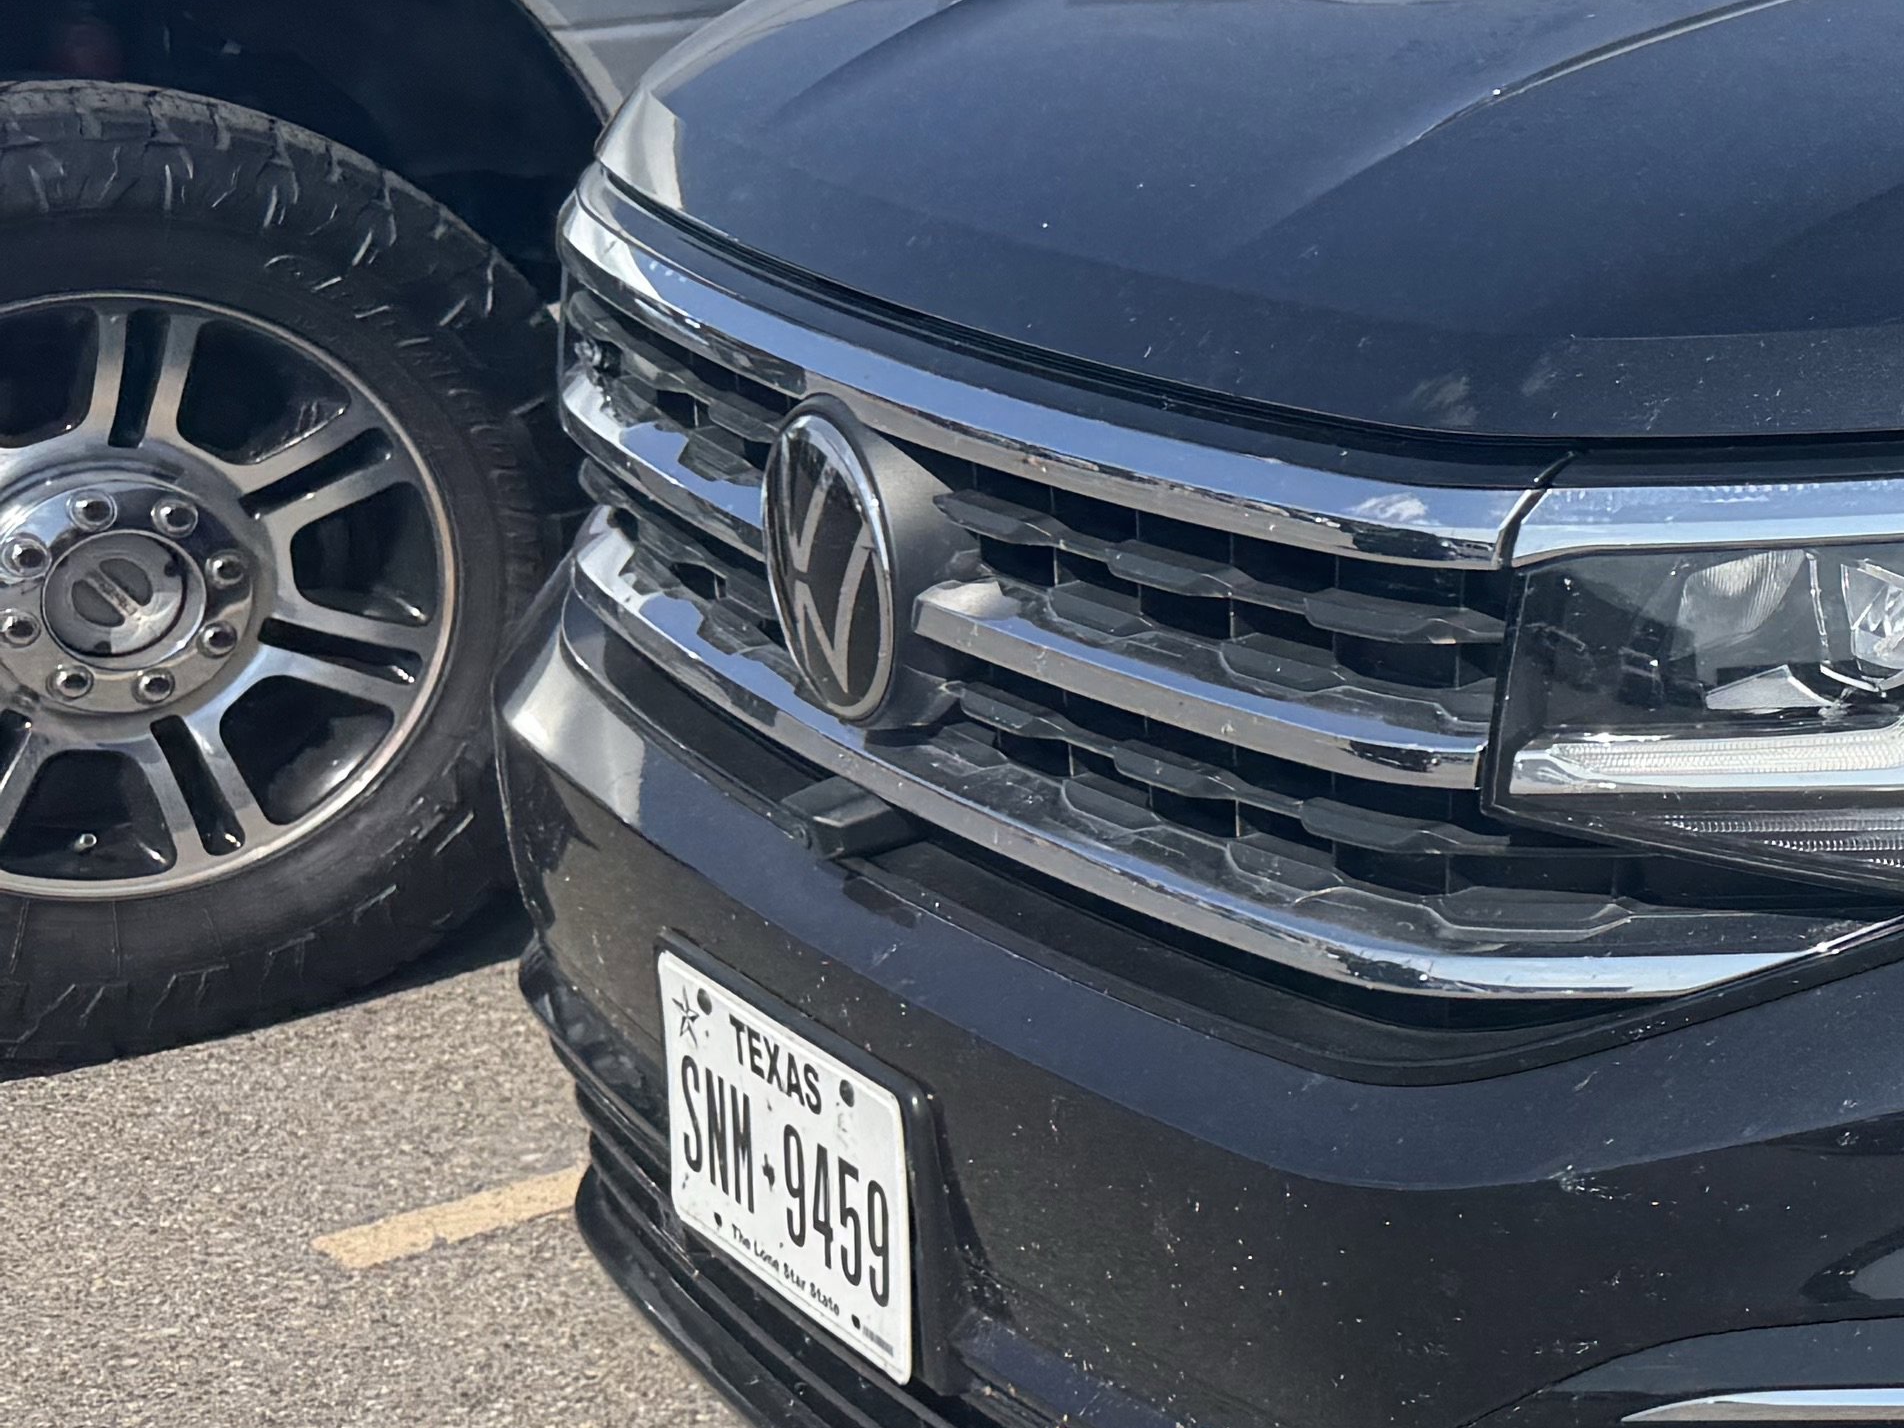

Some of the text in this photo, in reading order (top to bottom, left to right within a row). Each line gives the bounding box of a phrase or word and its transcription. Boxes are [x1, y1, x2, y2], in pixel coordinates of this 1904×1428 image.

[729, 1014, 823, 1115] TEXAS
[681, 1055, 890, 1308] SNM 9459
[783, 1262, 806, 1291] Star
[810, 1282, 840, 1317] State
